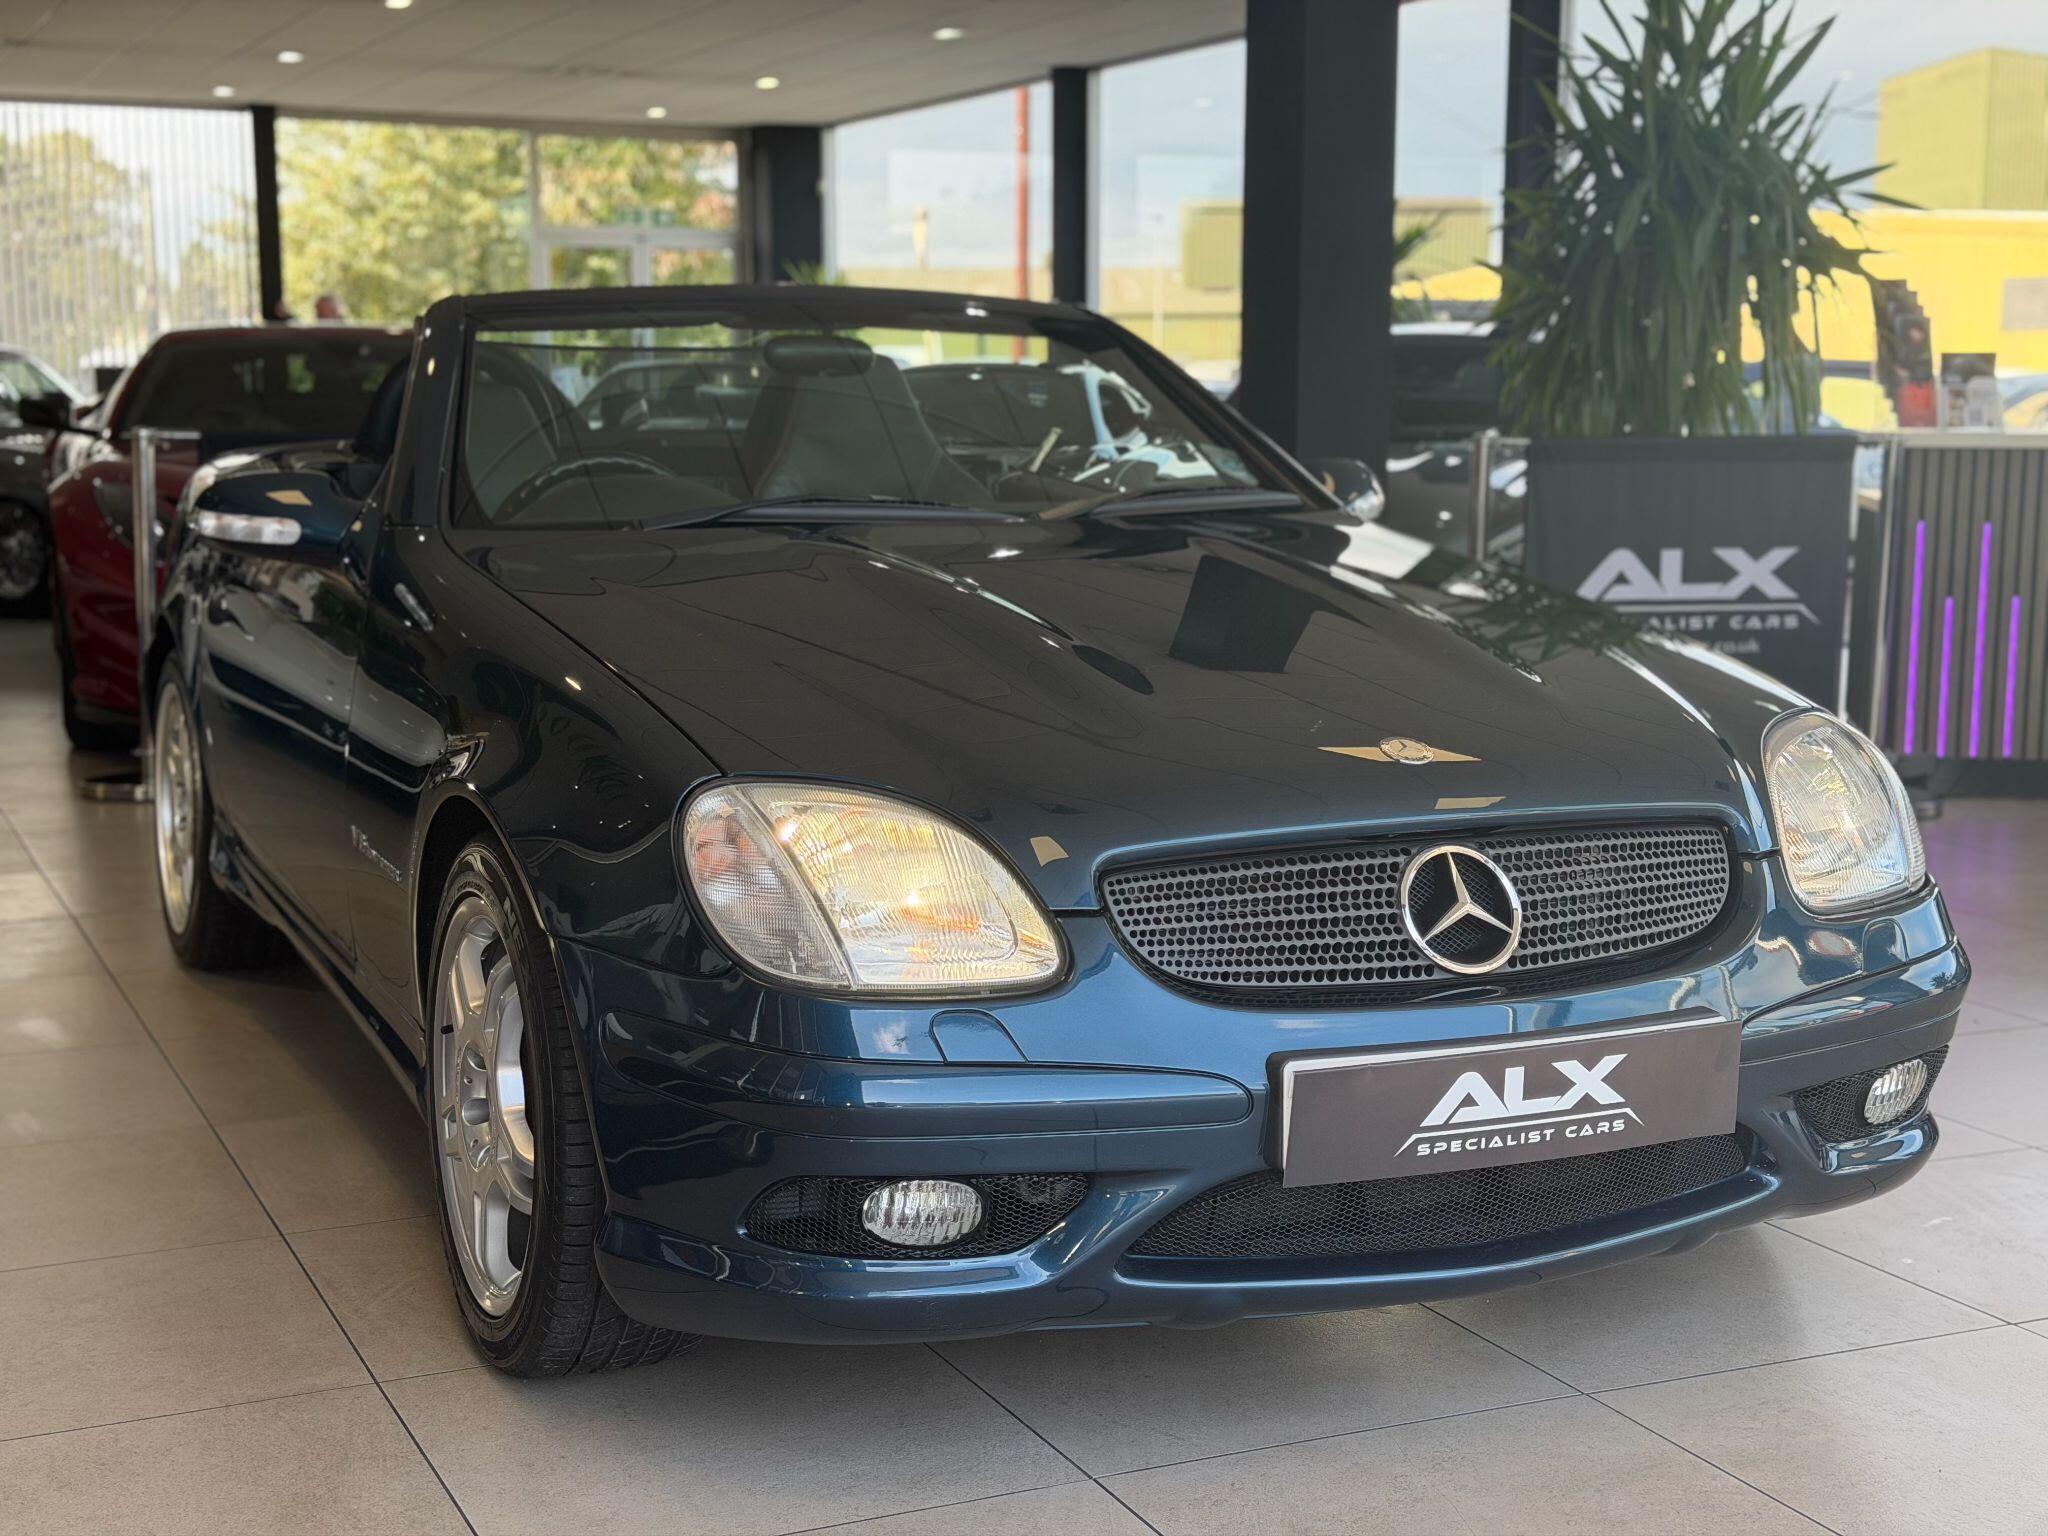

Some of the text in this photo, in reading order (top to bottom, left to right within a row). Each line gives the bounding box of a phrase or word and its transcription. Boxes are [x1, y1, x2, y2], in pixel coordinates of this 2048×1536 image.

[1576, 547, 1799, 601] ALX
[1649, 614, 1799, 631] ALIST CARS
[1420, 1053, 1628, 1127] ALX
[1417, 1119, 1626, 1156] SPECIALIST CARS
